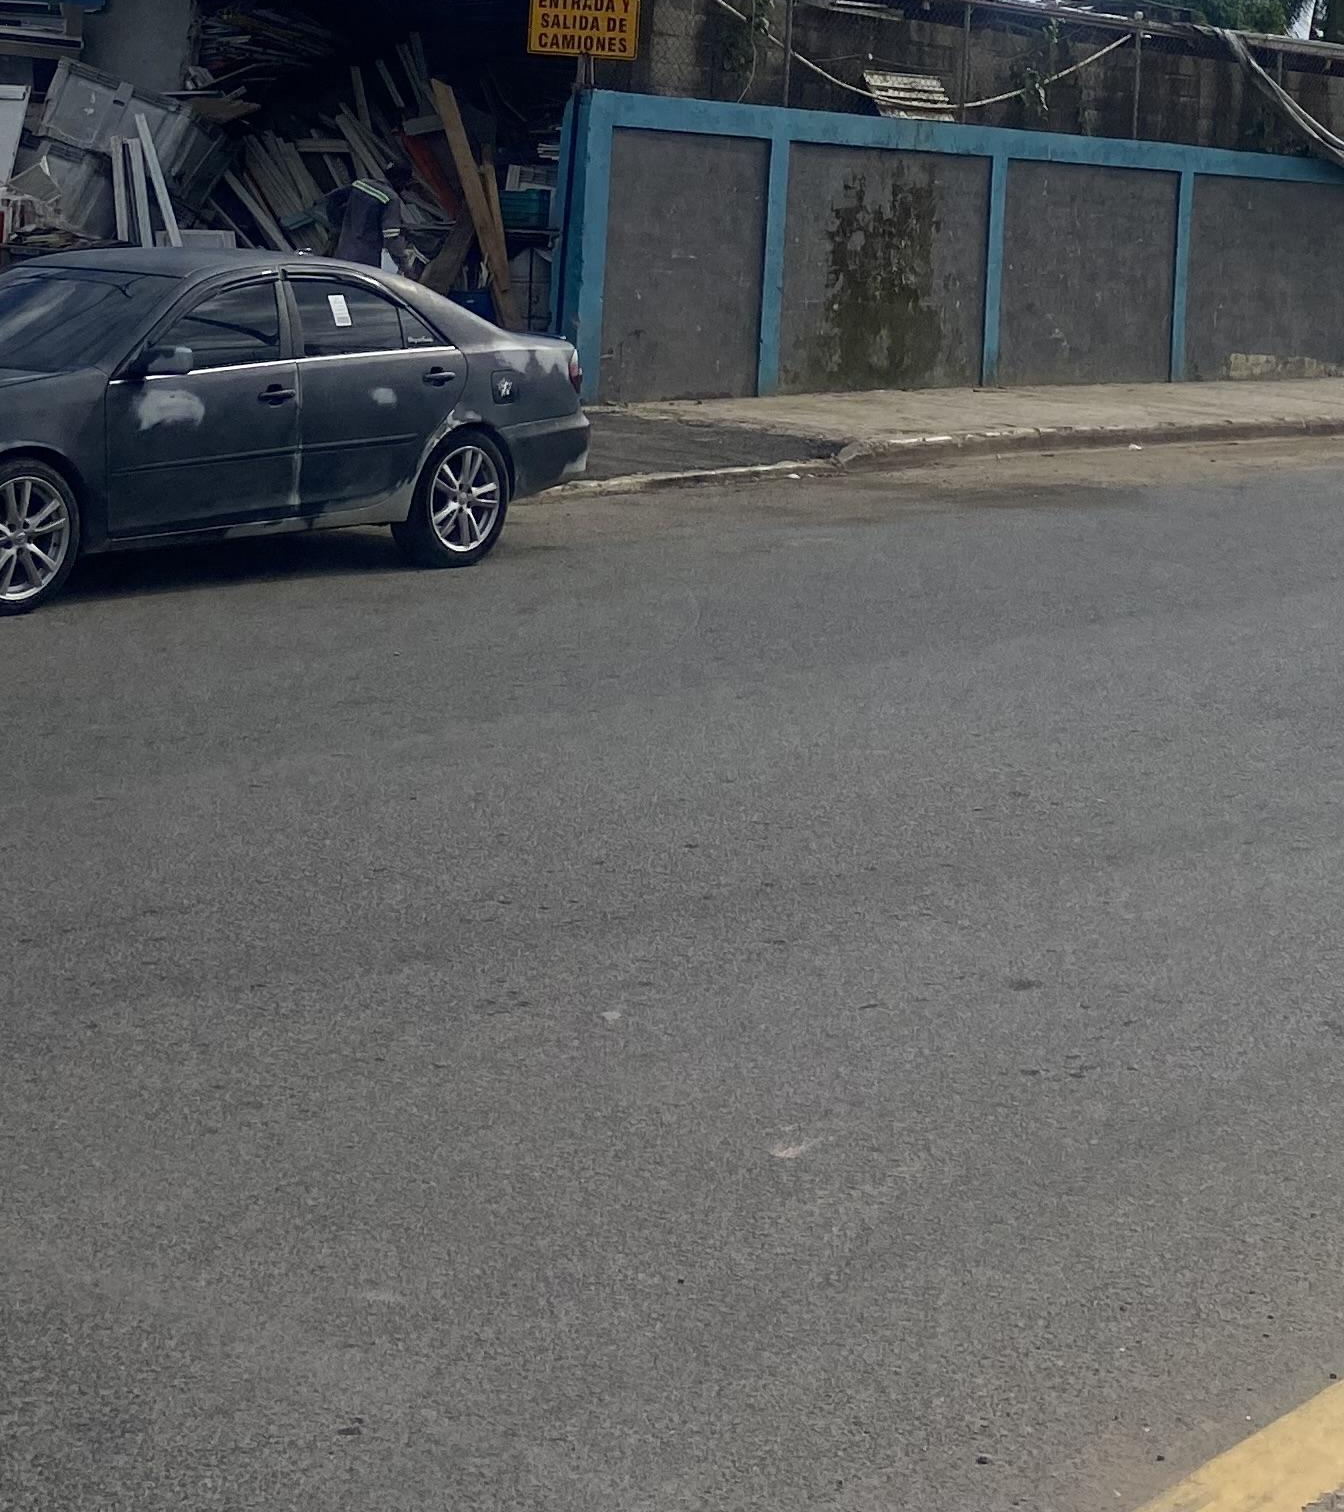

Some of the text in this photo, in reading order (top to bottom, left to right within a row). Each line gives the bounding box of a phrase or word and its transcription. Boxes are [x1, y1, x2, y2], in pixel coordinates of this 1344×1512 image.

[540, 12, 628, 34] SALIDA DE
[538, 32, 627, 53] CAMIONES
